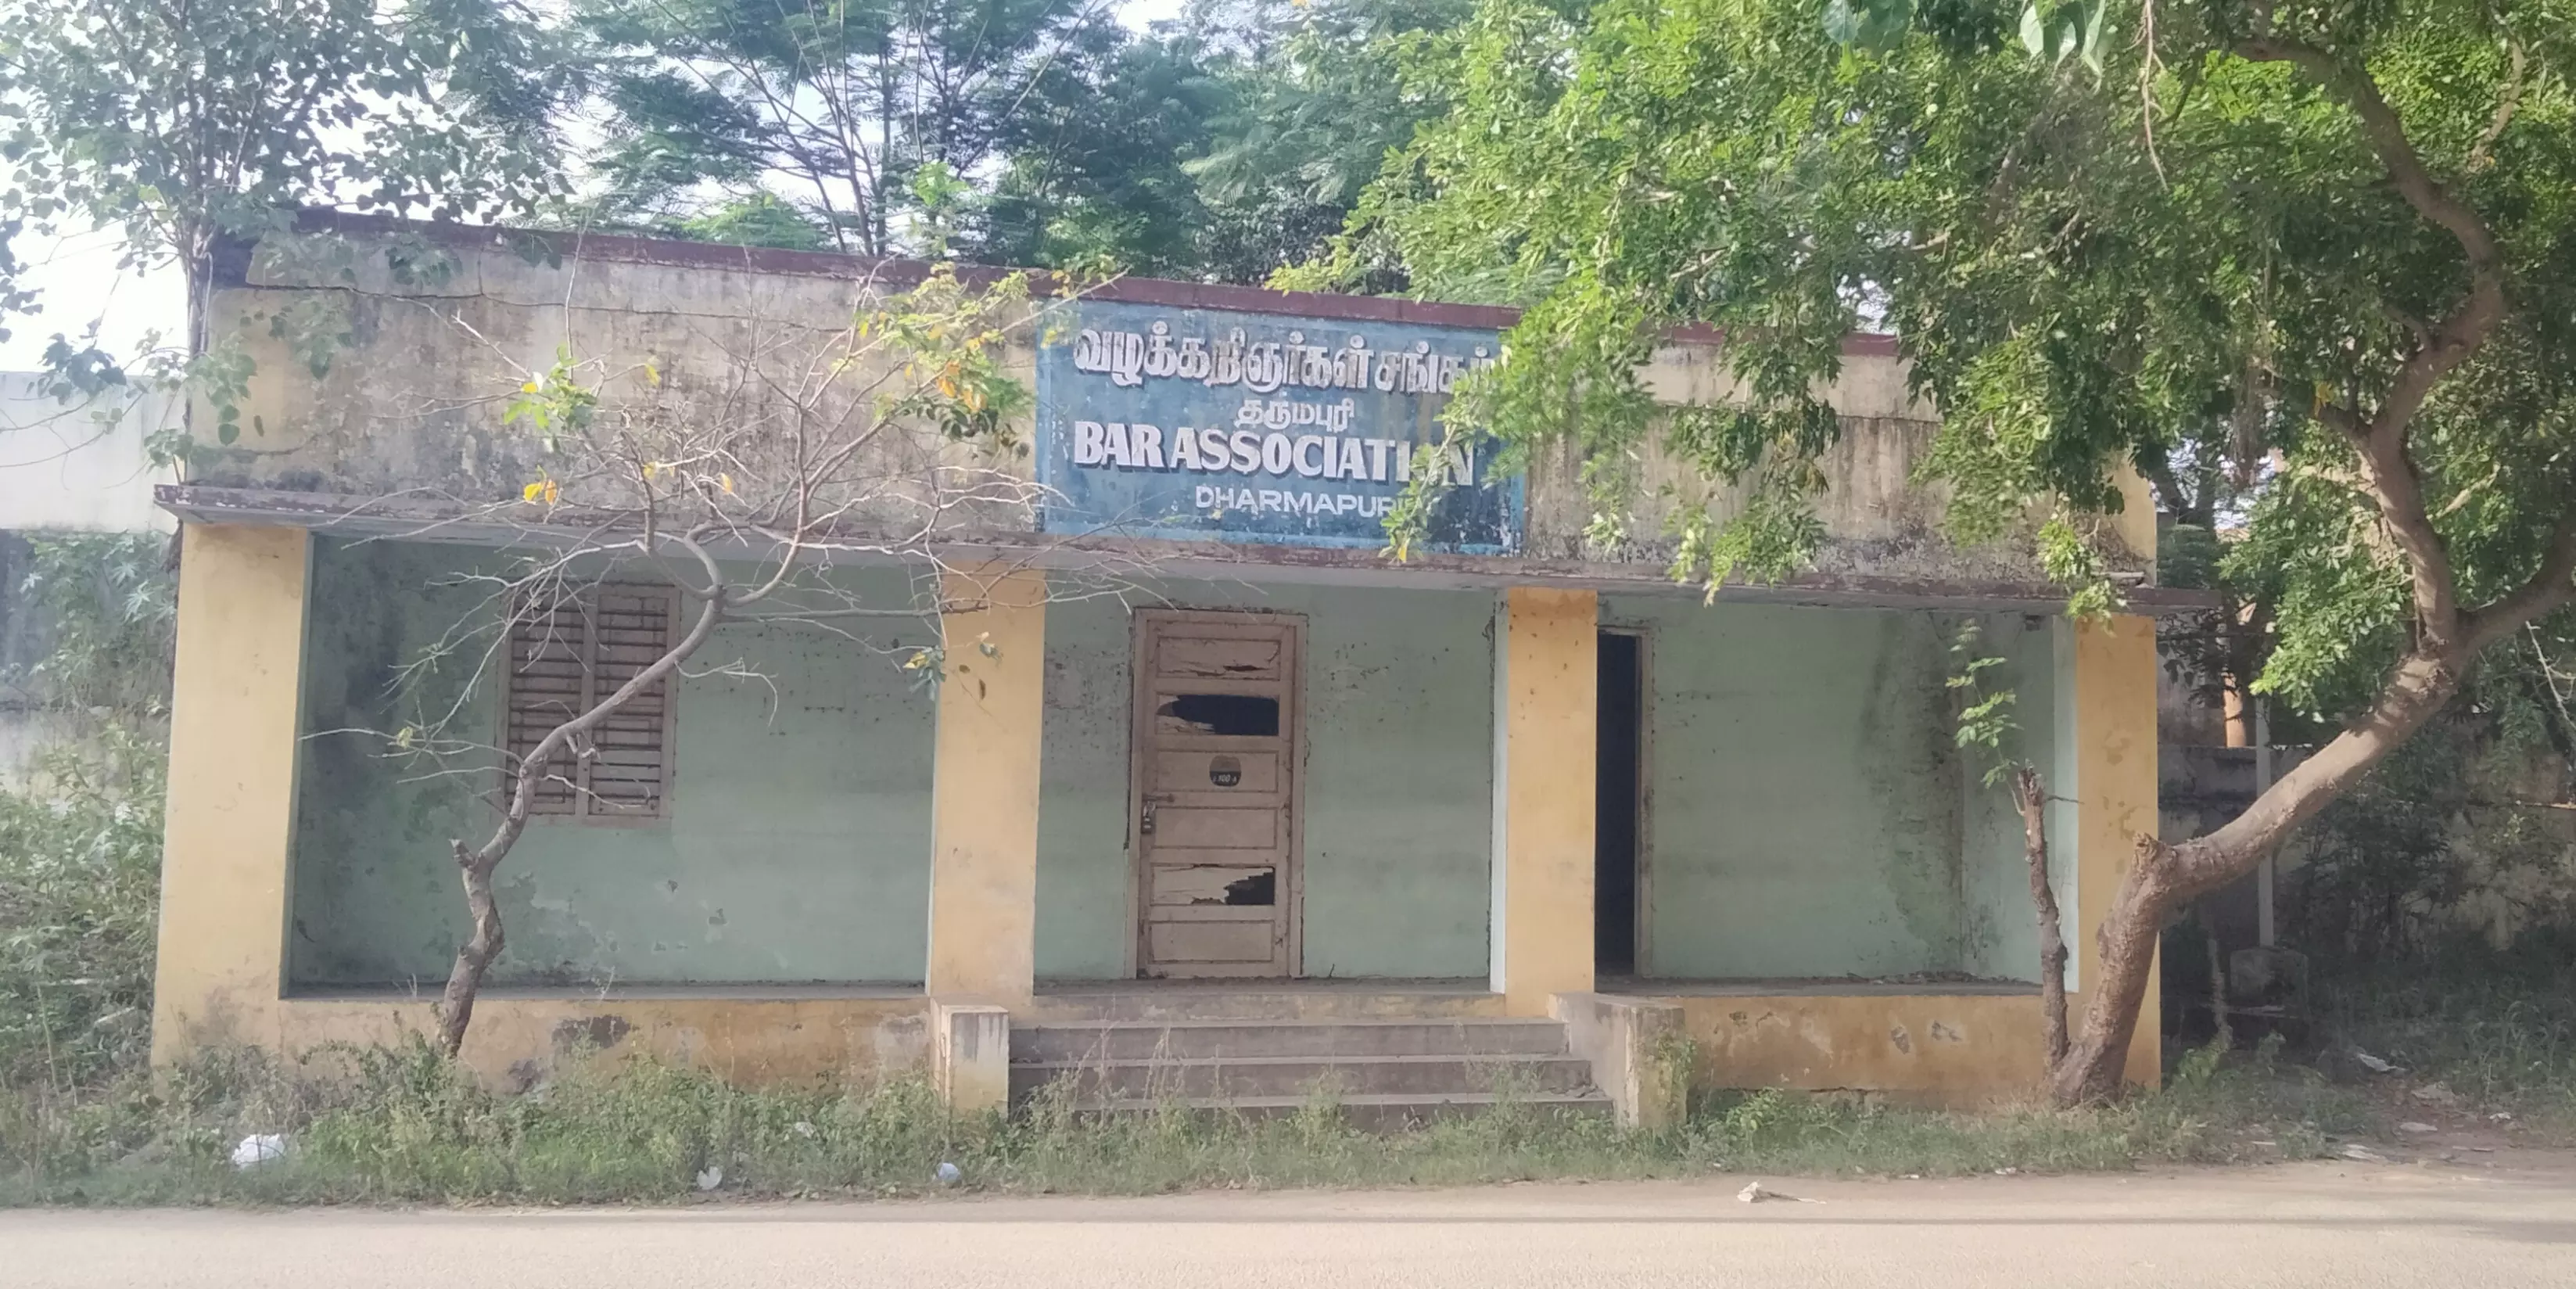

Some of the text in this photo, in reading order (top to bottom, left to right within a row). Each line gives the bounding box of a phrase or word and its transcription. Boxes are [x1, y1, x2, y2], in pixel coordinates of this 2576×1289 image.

[1233, 397, 1355, 433] தருமபுரி
[1075, 421, 1474, 487] BAR ASSOCIATIN
